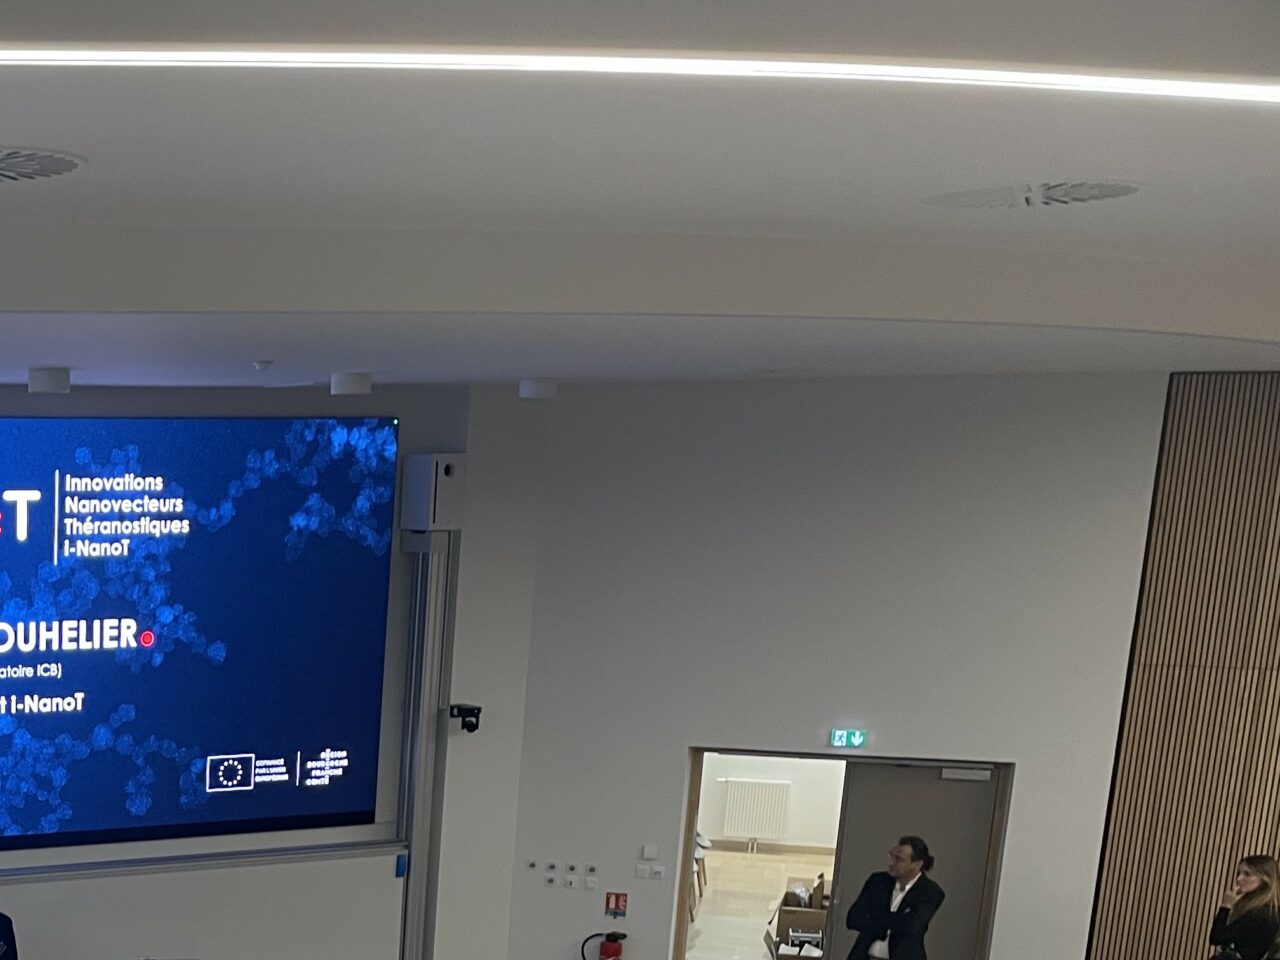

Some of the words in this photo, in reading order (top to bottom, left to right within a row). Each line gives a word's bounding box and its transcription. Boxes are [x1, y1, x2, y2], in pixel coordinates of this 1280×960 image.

[65, 473, 163, 492] Innovations
[64, 495, 184, 514] Nanovecteurs
[63, 516, 190, 538] Théranostiques
[63, 538, 131, 557] i-NanoT
[37, 662, 62, 679] ICB)
